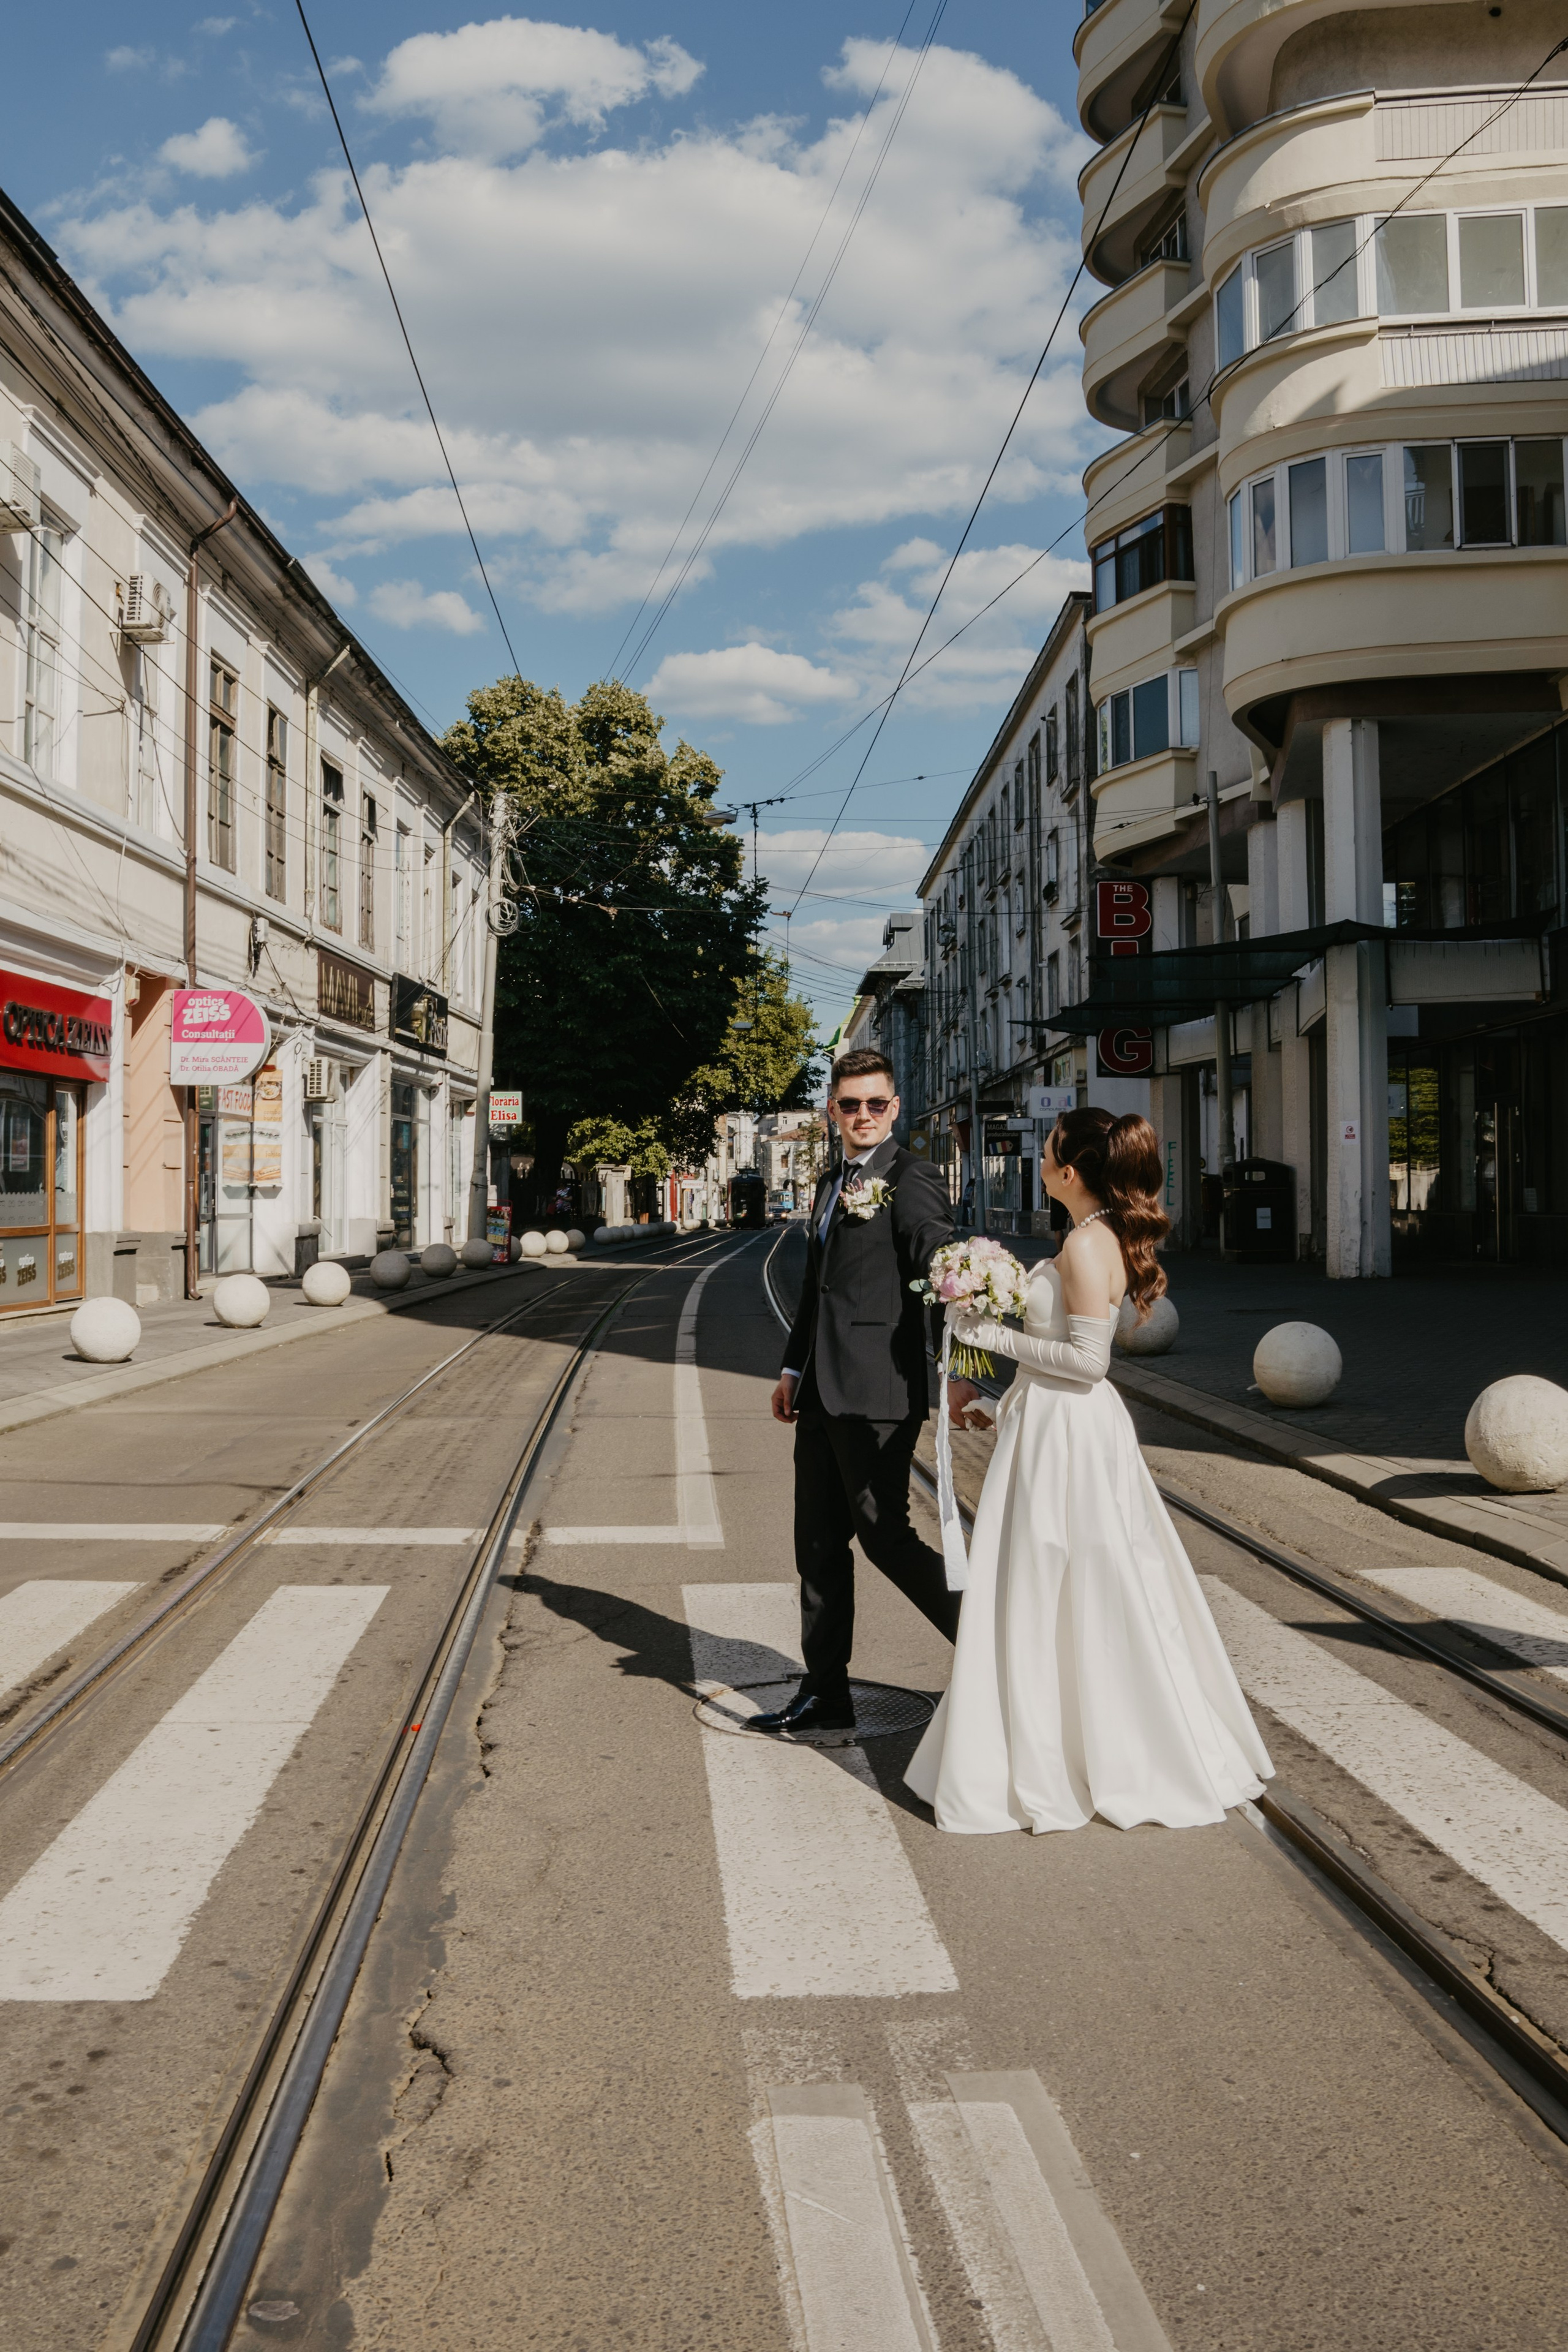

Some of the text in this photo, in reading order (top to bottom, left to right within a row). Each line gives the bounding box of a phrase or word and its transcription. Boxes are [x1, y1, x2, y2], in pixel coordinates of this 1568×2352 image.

[187, 995, 225, 1008] optica
[183, 1004, 232, 1025] ZEISS
[3, 1001, 112, 1056] OPTICA ZEISS
[181, 1029, 235, 1041] Consultații
[217, 1088, 252, 1112] FAST FOOD
[491, 1110, 517, 1120] Elisa
[1166, 1142, 1177, 1206] FEEL
[17, 1263, 37, 1287] ZEISS
[58, 1259, 75, 1281] ZEISS
